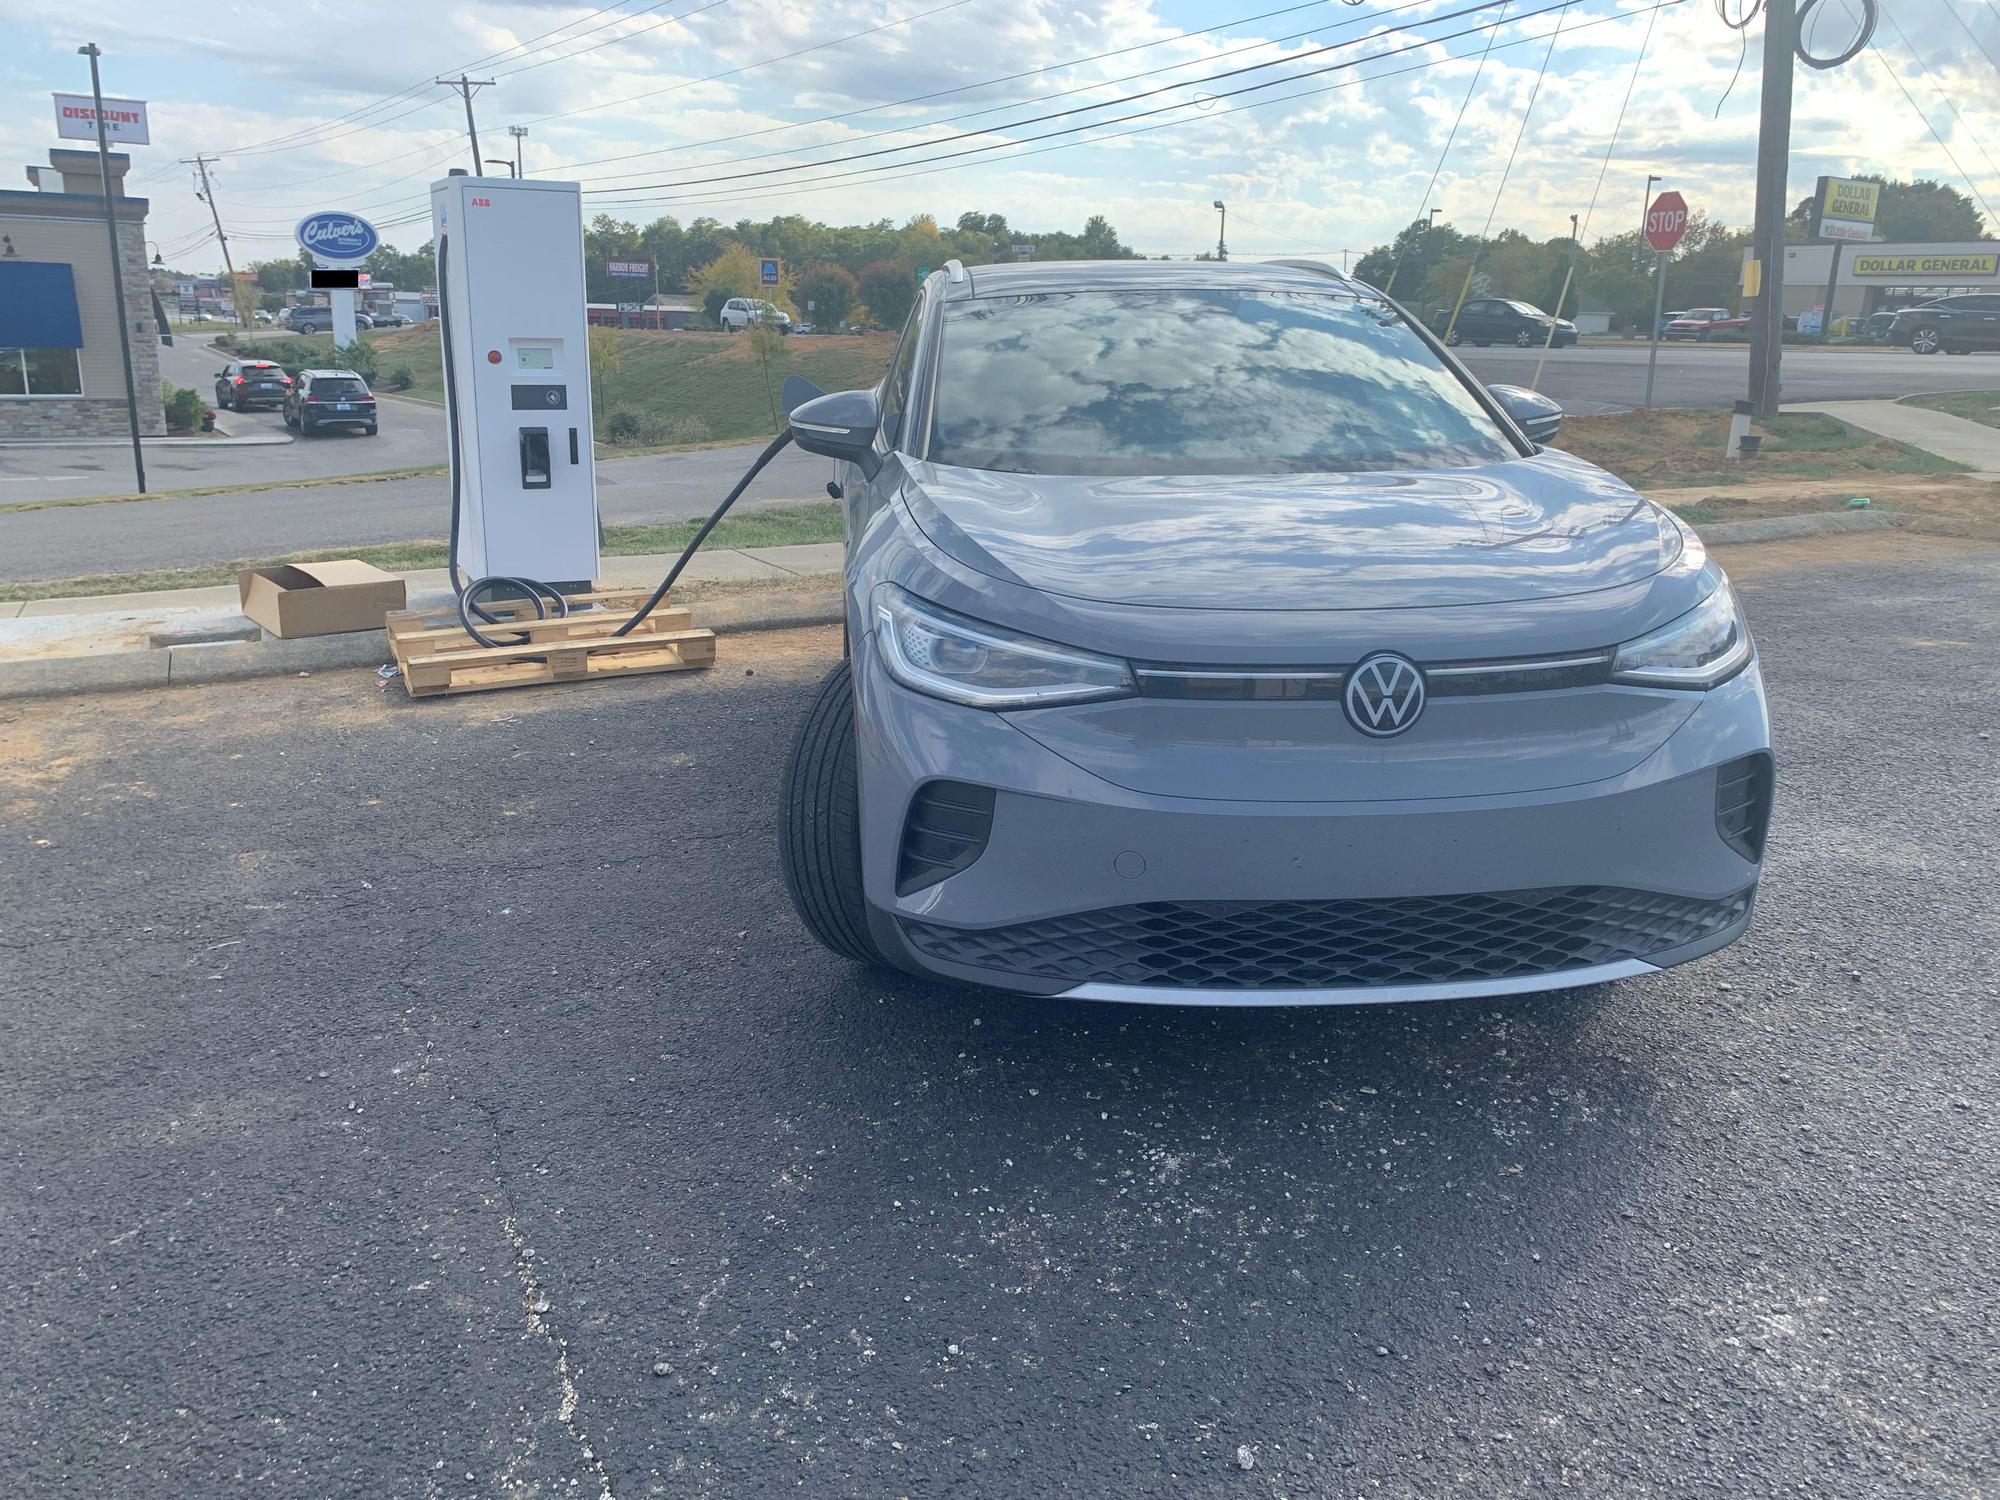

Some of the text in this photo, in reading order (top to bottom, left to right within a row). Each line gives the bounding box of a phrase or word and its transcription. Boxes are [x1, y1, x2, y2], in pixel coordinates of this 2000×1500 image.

[87, 121, 120, 131] TRE
[1837, 184, 1871, 201] DOLLAR
[472, 198, 490, 207] ABB
[1832, 199, 1870, 216] GENERAL
[1648, 210, 1685, 233] STOP
[303, 219, 364, 245] Culver's
[1859, 258, 1990, 272] DOLLAR GENERAL
[1350, 658, 1421, 728] VW
